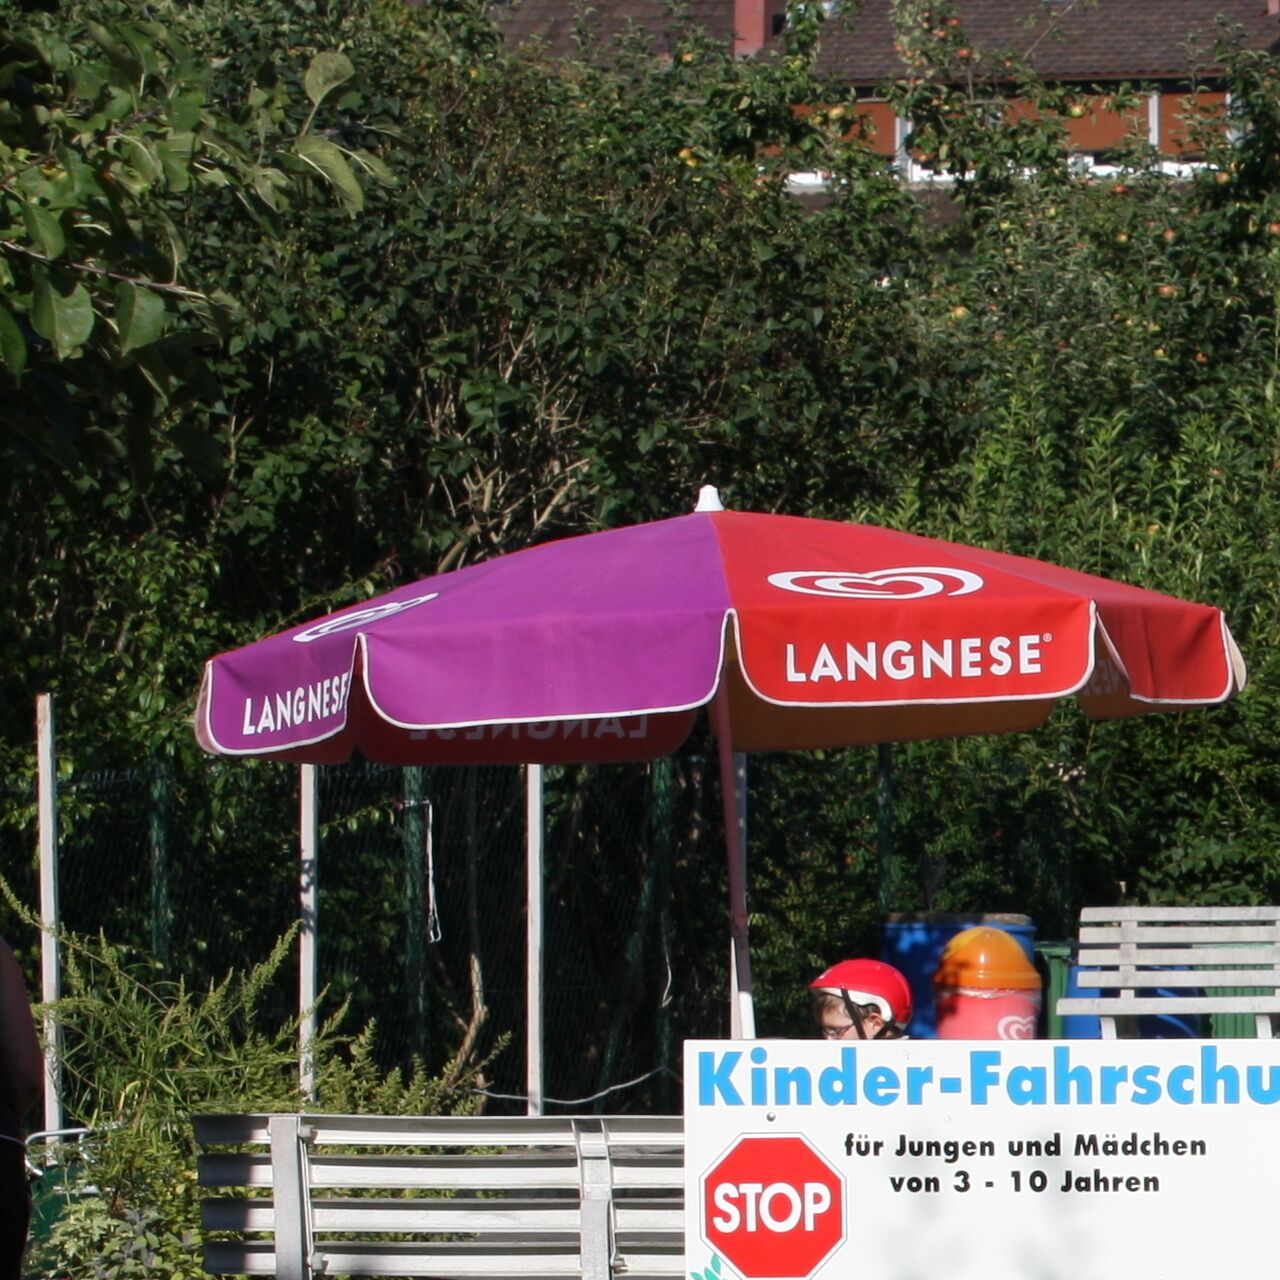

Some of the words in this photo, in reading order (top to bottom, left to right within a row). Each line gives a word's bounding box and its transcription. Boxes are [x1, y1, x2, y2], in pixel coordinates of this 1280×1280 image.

[844, 1132, 884, 1157] für
[895, 1133, 995, 1164] Jungen
[1008, 1132, 1061, 1157] und
[1074, 1132, 1206, 1156] Mädchen
[890, 1176, 940, 1193] von
[953, 1170, 970, 1193] 3
[1011, 1170, 1048, 1193] 10
[1060, 1169, 1159, 1193] Jahren
[712, 1182, 832, 1234] STOP
